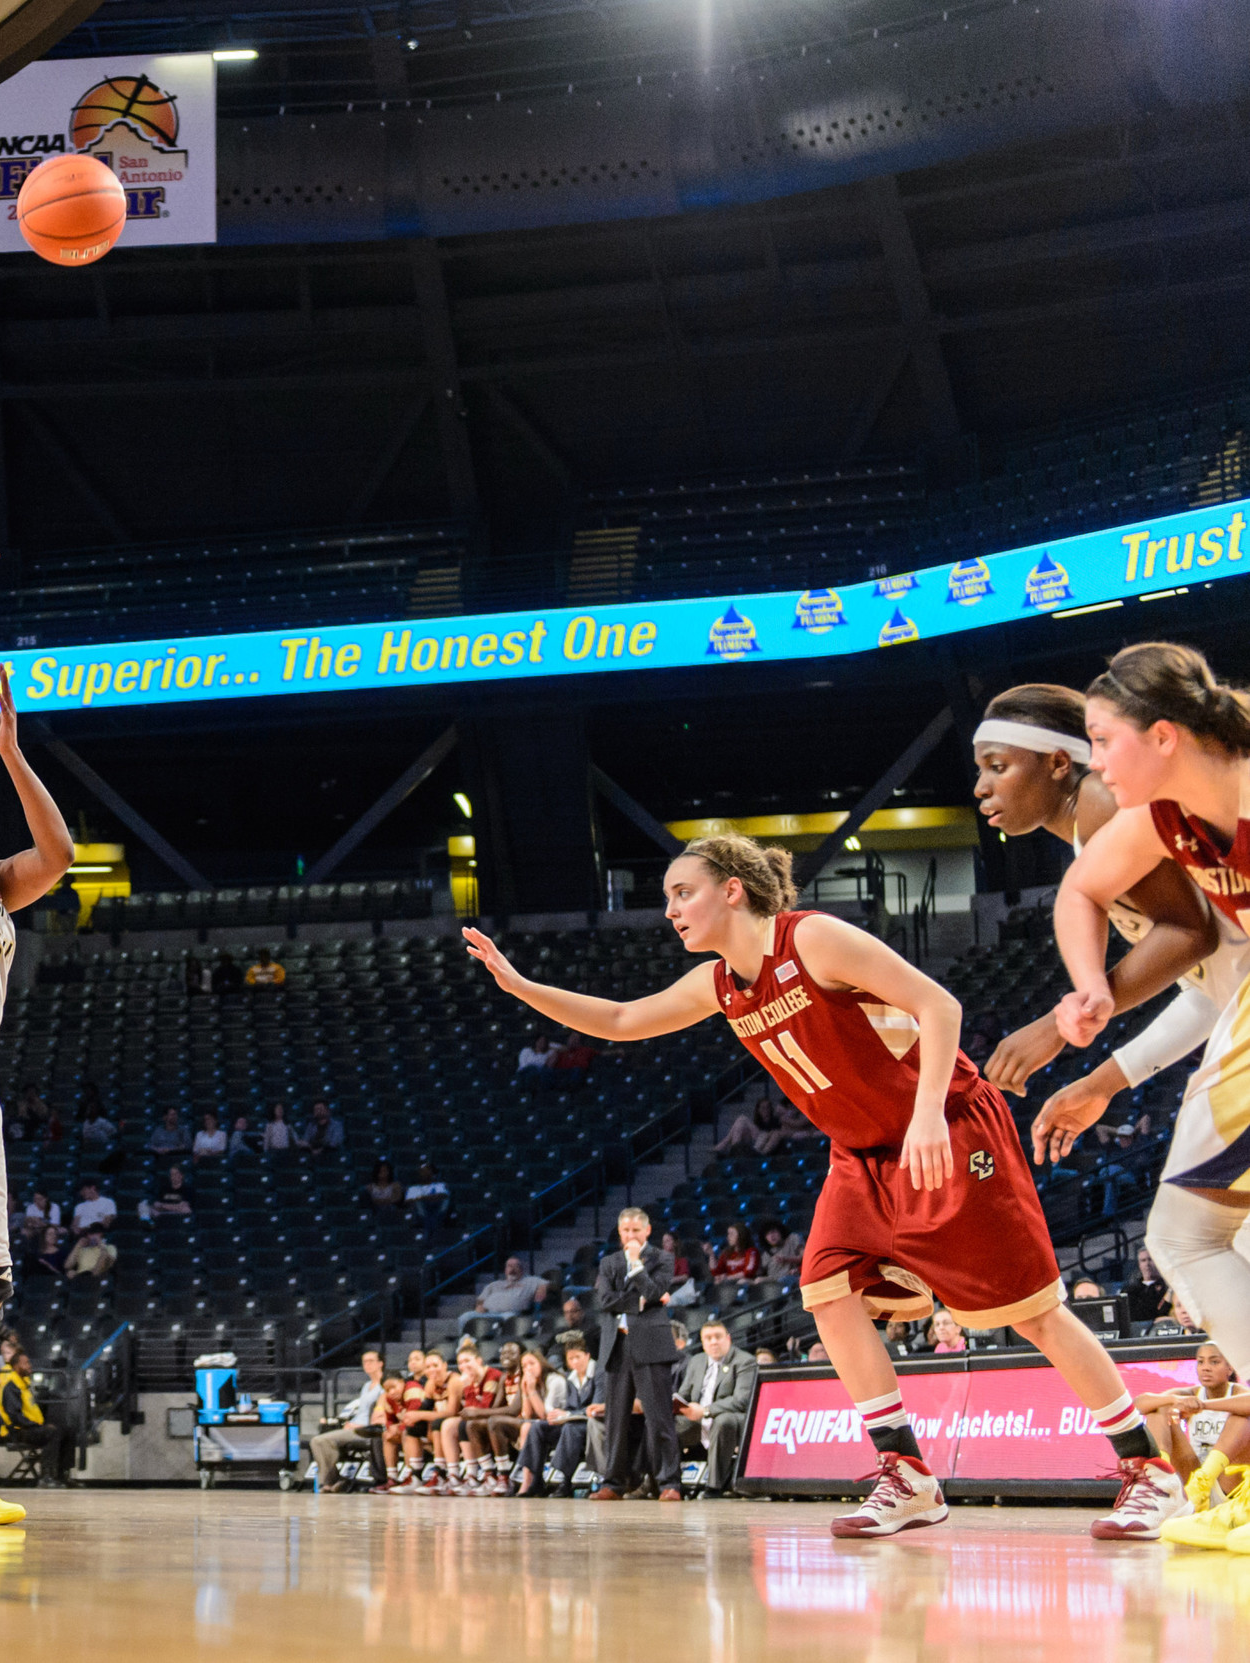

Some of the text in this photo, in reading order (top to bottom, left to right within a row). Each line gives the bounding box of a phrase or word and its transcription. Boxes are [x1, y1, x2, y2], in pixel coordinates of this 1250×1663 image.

[119, 155, 148, 169] San
[120, 168, 183, 184] Antonio
[1122, 512, 1246, 582] Trust
[280, 636, 362, 681] The
[377, 620, 547, 674] Honest
[563, 615, 658, 661] One
[760, 984, 813, 1028] COLLEGE
[759, 1030, 833, 1094] 11
[760, 1407, 863, 1455] EQUIFAX
